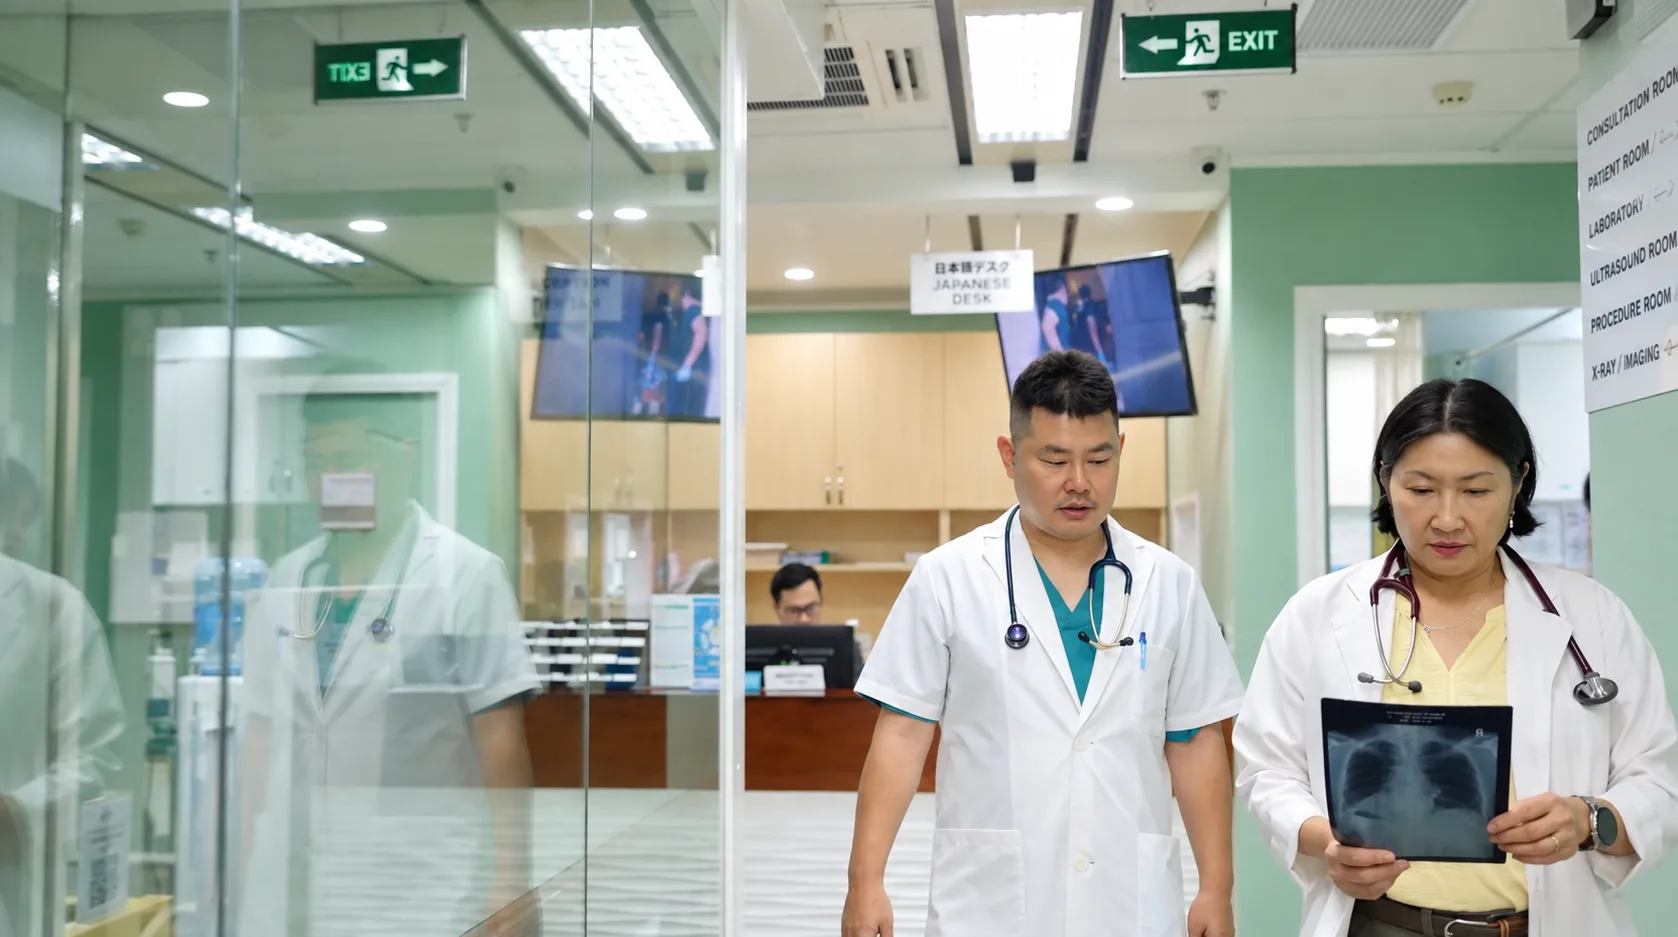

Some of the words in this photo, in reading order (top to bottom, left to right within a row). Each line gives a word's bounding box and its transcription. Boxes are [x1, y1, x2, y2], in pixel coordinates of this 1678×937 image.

[1228, 30, 1278, 51] EXIT
[1587, 87, 1650, 146] CONSULTATION
[1588, 158, 1621, 192] PATIENT
[1622, 139, 1650, 171] ROOM
[1588, 194, 1644, 239] LABORATORY
[935, 261, 1009, 274] 日本語デスク
[1590, 247, 1646, 287] ULTRASOUND
[1648, 230, 1678, 260] ROOM
[932, 278, 1011, 291] JAPANESE
[952, 293, 993, 305] DESK
[1591, 299, 1641, 334] PROCEDURE
[1643, 286, 1672, 314] ROOM
[1592, 358, 1616, 381] X-RAY
[1617, 354, 1623, 375] /
[1624, 343, 1660, 371] IMAGING
